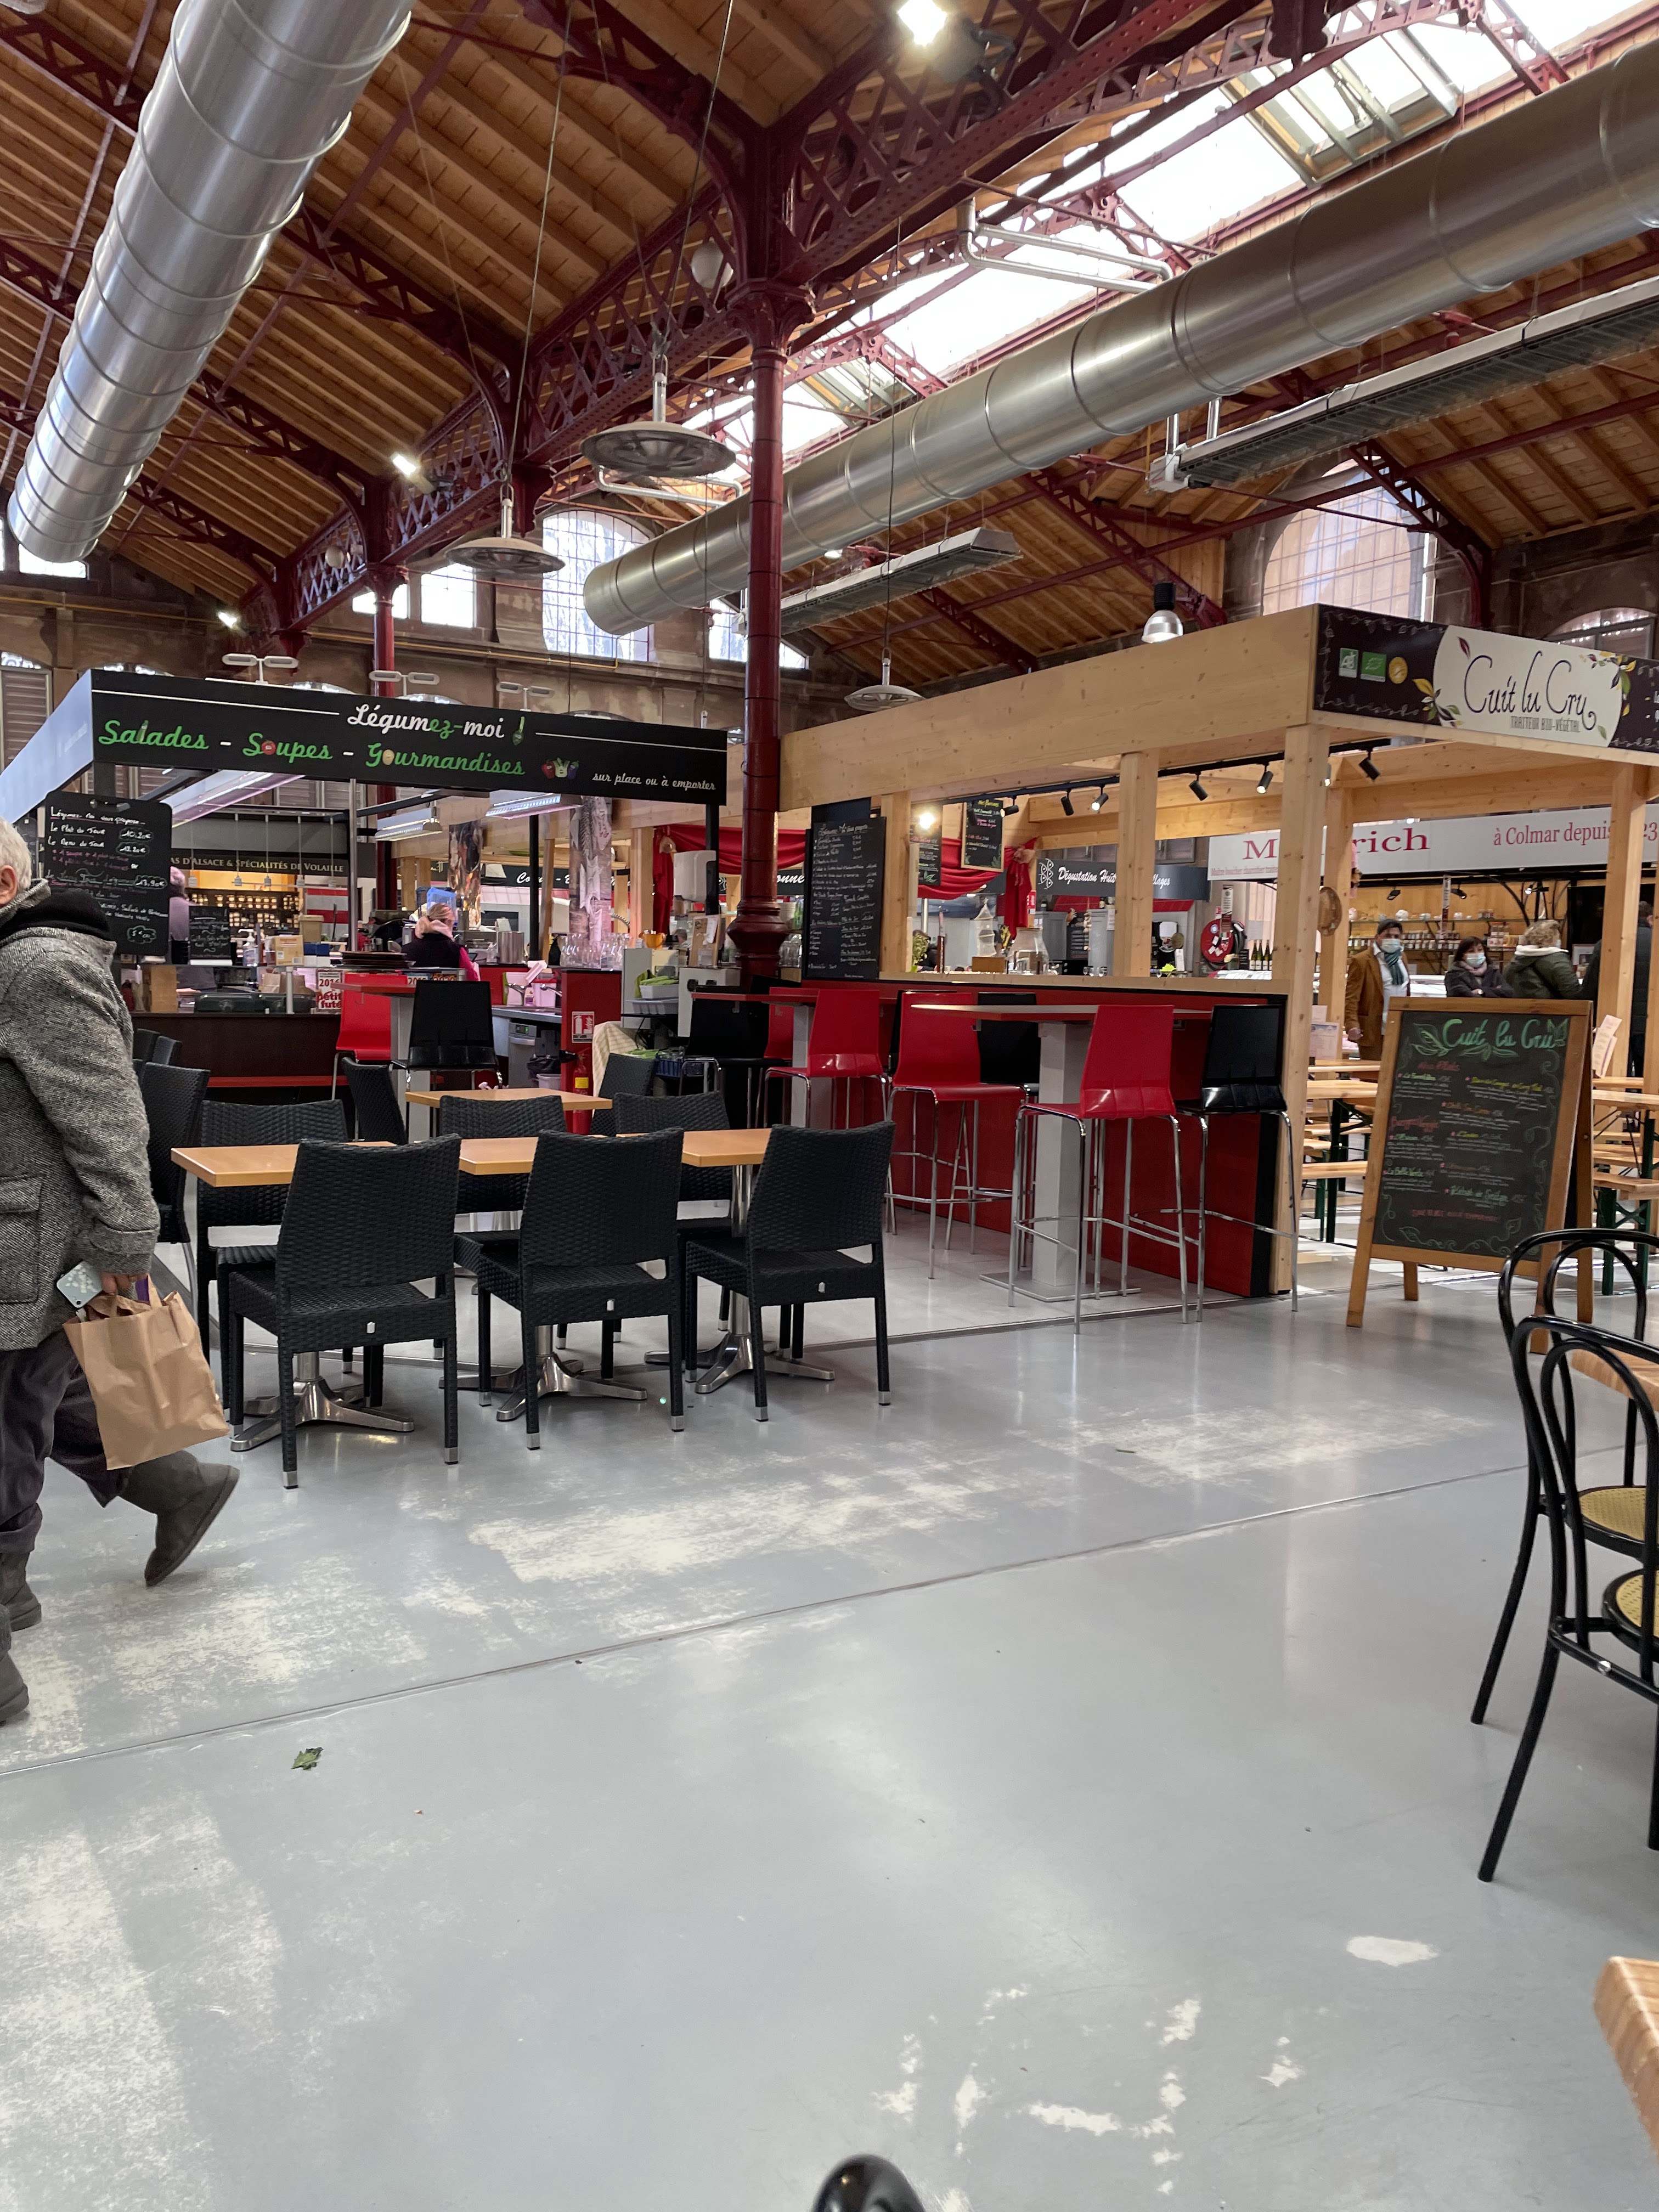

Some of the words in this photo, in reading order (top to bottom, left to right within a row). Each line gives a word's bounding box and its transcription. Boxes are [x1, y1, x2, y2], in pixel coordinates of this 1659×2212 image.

[1464, 654, 1516, 714] Cuit
[98, 719, 210, 750] Salades
[242, 732, 333, 764] Soupes
[365, 742, 526, 775] Gourmandises
[591, 773, 612, 782] sur
[614, 772, 642, 786] place
[661, 775, 669, 787] à
[672, 780, 716, 791] emporter
[50, 822, 59, 832] Le
[1493, 827, 1502, 845] à
[1506, 825, 1560, 845] Colmar
[304, 862, 344, 872] VOLAILLE
[1058, 866, 1098, 884] Dégustation
[1443, 1018, 1488, 1047] Cuit
